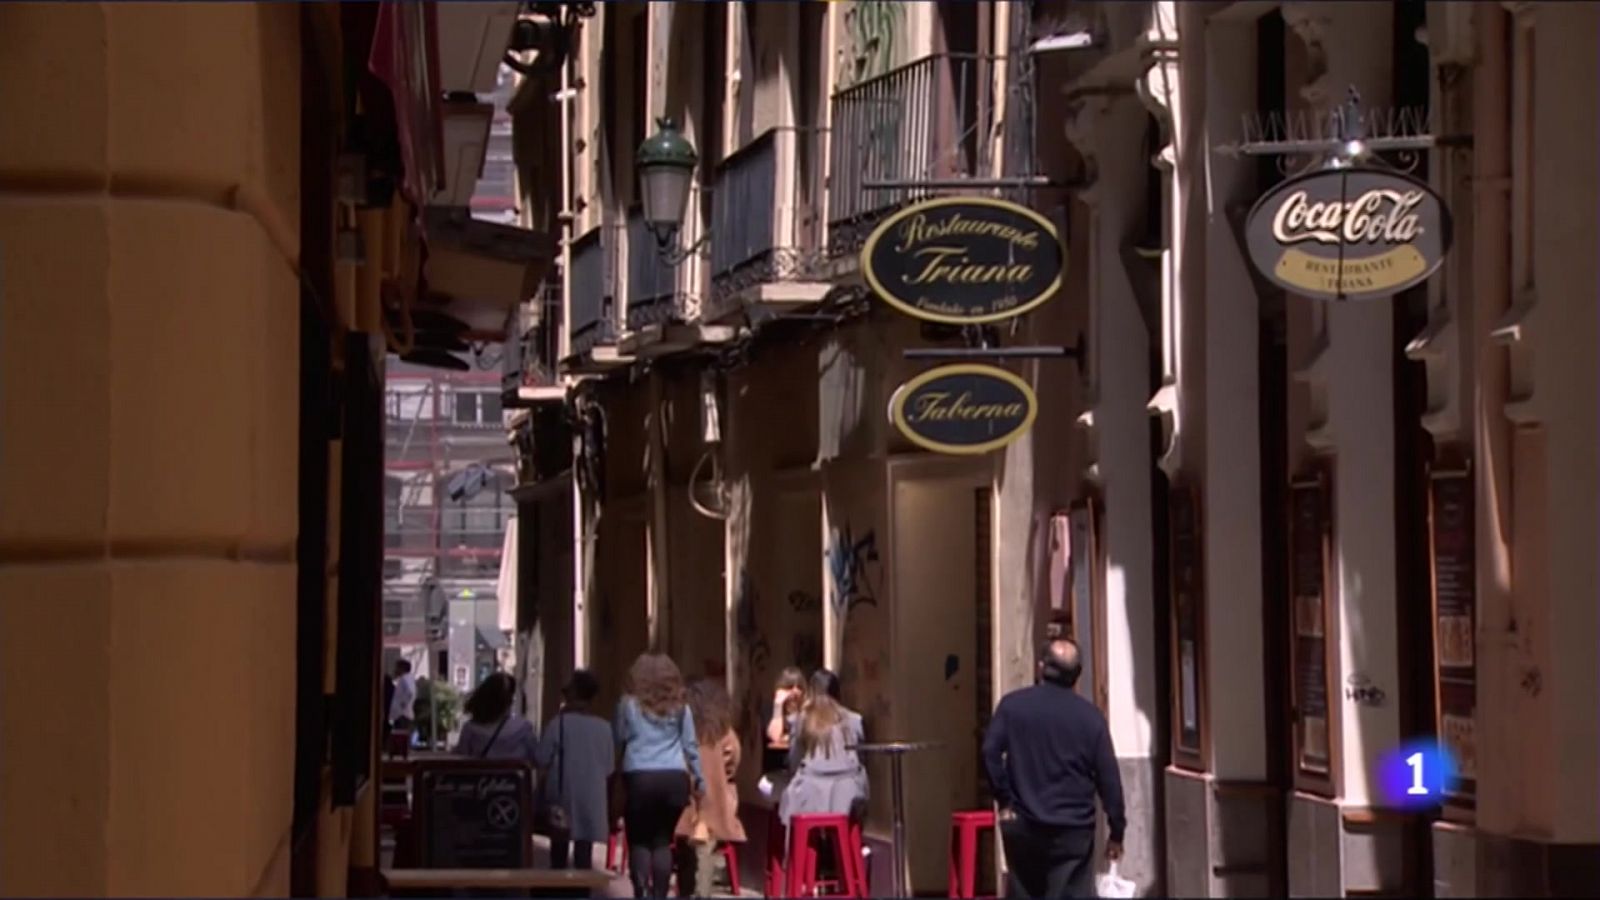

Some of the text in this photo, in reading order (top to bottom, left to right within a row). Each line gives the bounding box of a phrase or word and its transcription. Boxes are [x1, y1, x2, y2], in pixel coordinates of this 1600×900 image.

[895, 213, 1039, 250] Restaurante
[1273, 190, 1424, 243] Coca-Cola
[901, 246, 1035, 284] Triana
[1305, 258, 1393, 275] RESTURANTE
[907, 390, 1023, 422] Taberna
